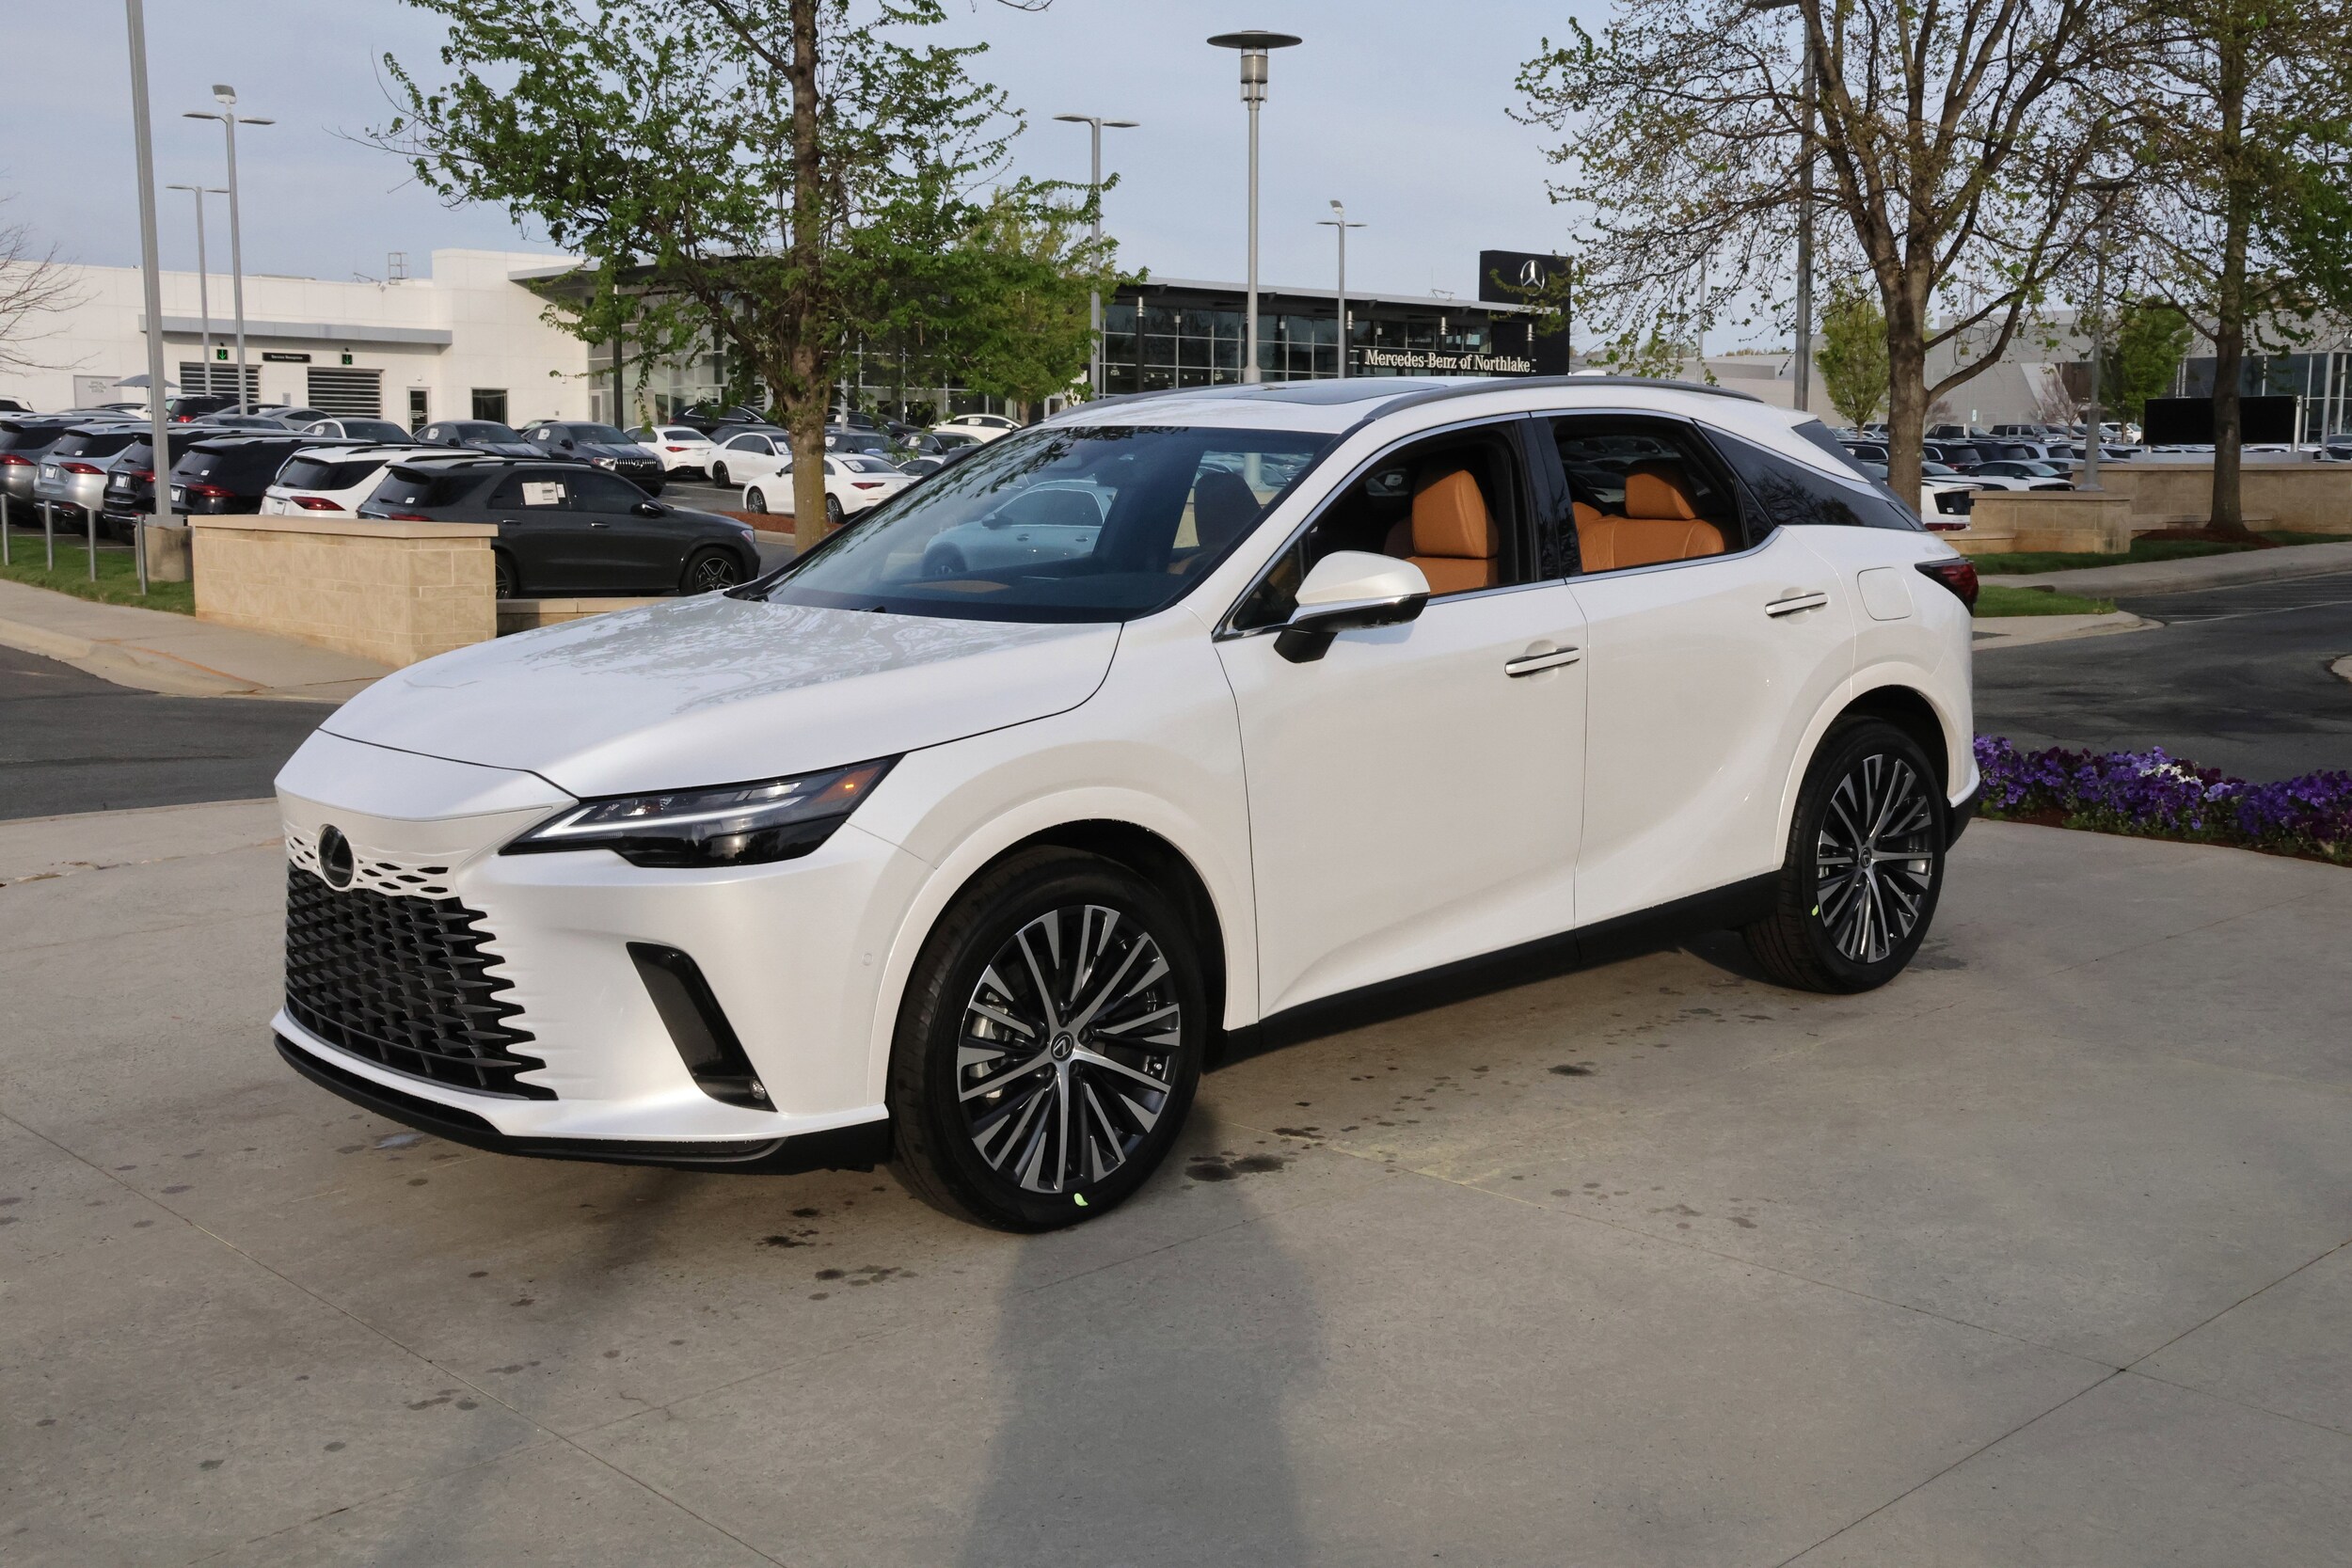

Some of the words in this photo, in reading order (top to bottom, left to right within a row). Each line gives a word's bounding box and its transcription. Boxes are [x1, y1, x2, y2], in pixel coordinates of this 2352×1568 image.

[1364, 349, 1457, 369] Mercedes-Benz
[1459, 354, 1473, 371] of
[1473, 355, 1531, 372] Northlake
